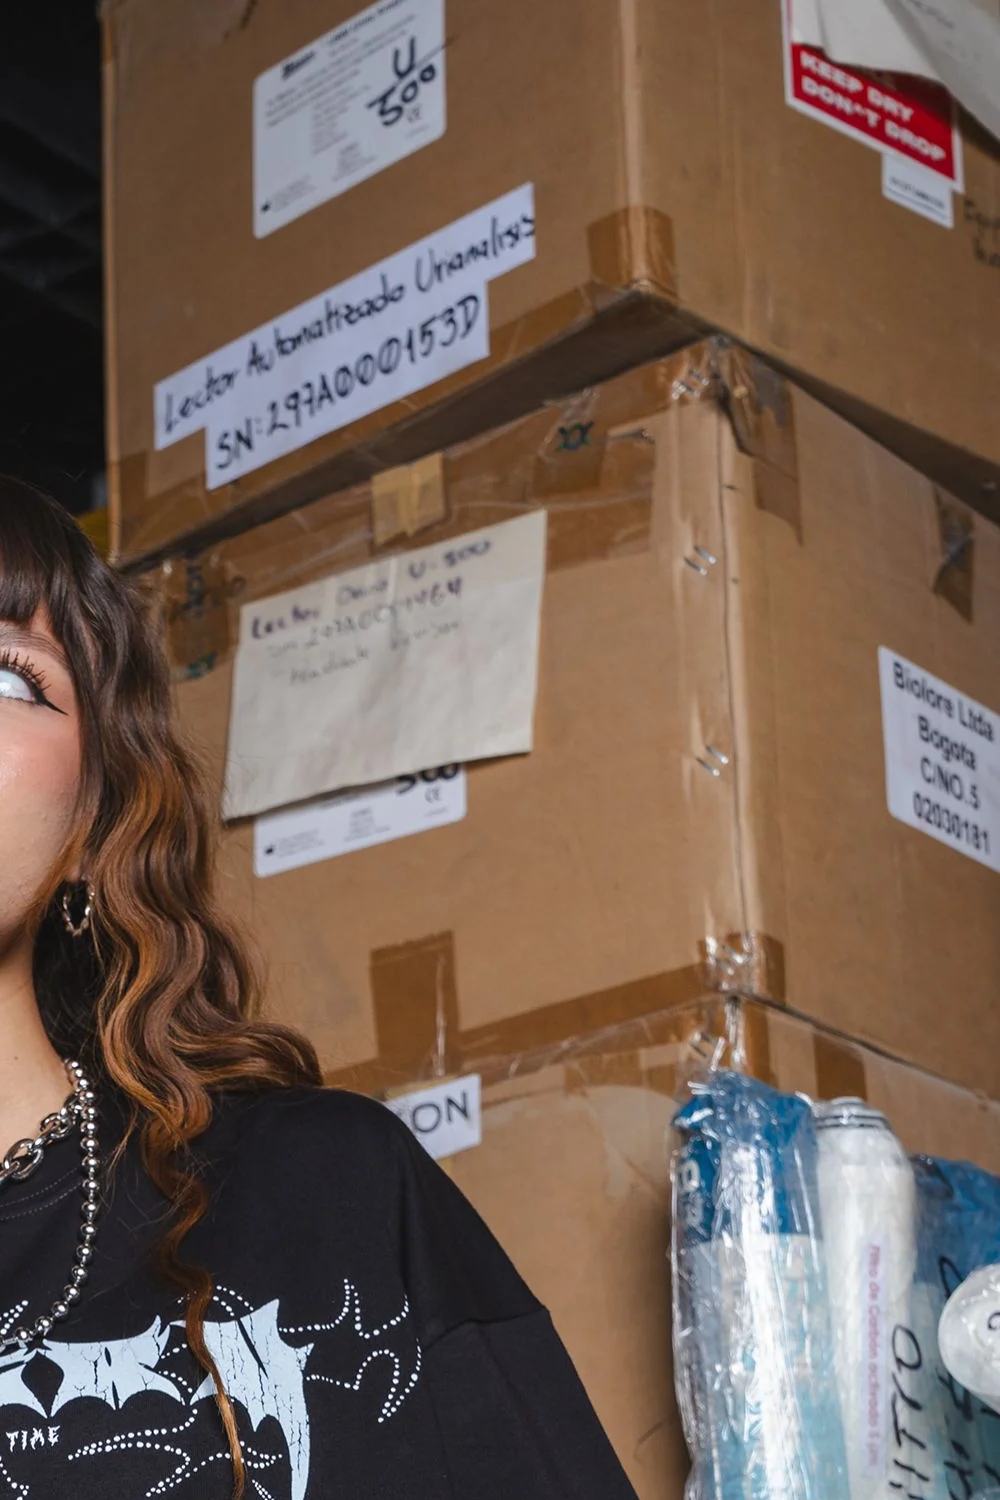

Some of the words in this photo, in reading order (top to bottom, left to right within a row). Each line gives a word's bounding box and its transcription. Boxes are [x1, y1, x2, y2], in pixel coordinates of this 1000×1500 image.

[393, 36, 416, 80] U
[801, 51, 863, 93] KEEP
[867, 86, 914, 122] DRY
[884, 121, 946, 162] DROP
[164, 369, 240, 434] Lector
[247, 273, 405, 372] Automatizado
[918, 714, 976, 771] Bogota
[958, 698, 995, 743] Ltda
[913, 791, 990, 854] 02030181
[5, 1425, 62, 1449] TIME
